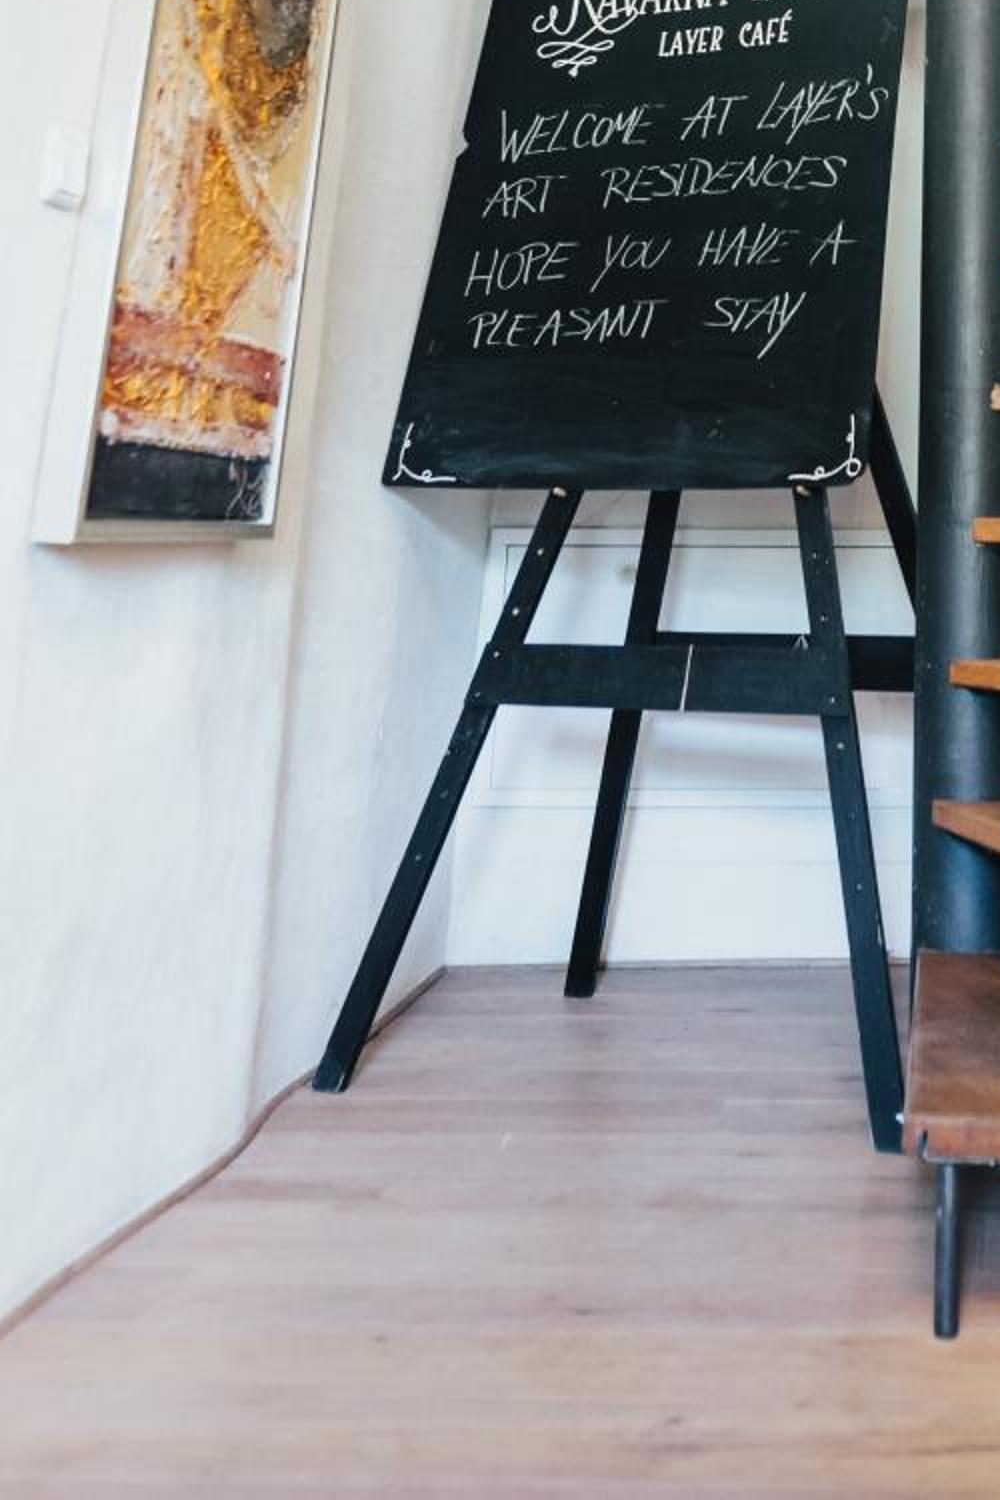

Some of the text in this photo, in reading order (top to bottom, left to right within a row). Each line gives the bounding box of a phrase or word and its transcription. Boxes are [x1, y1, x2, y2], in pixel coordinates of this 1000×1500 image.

[658, 9, 793, 57] LAYER CAFÉ
[501, 64, 889, 163] WELCOME AT LAYER'S
[482, 154, 848, 218] ART RESIDENCES
[464, 241, 580, 298] HOPE
[698, 222, 800, 268] HAVE
[809, 219, 858, 267] A
[468, 292, 807, 361] PLEASANT STAY
